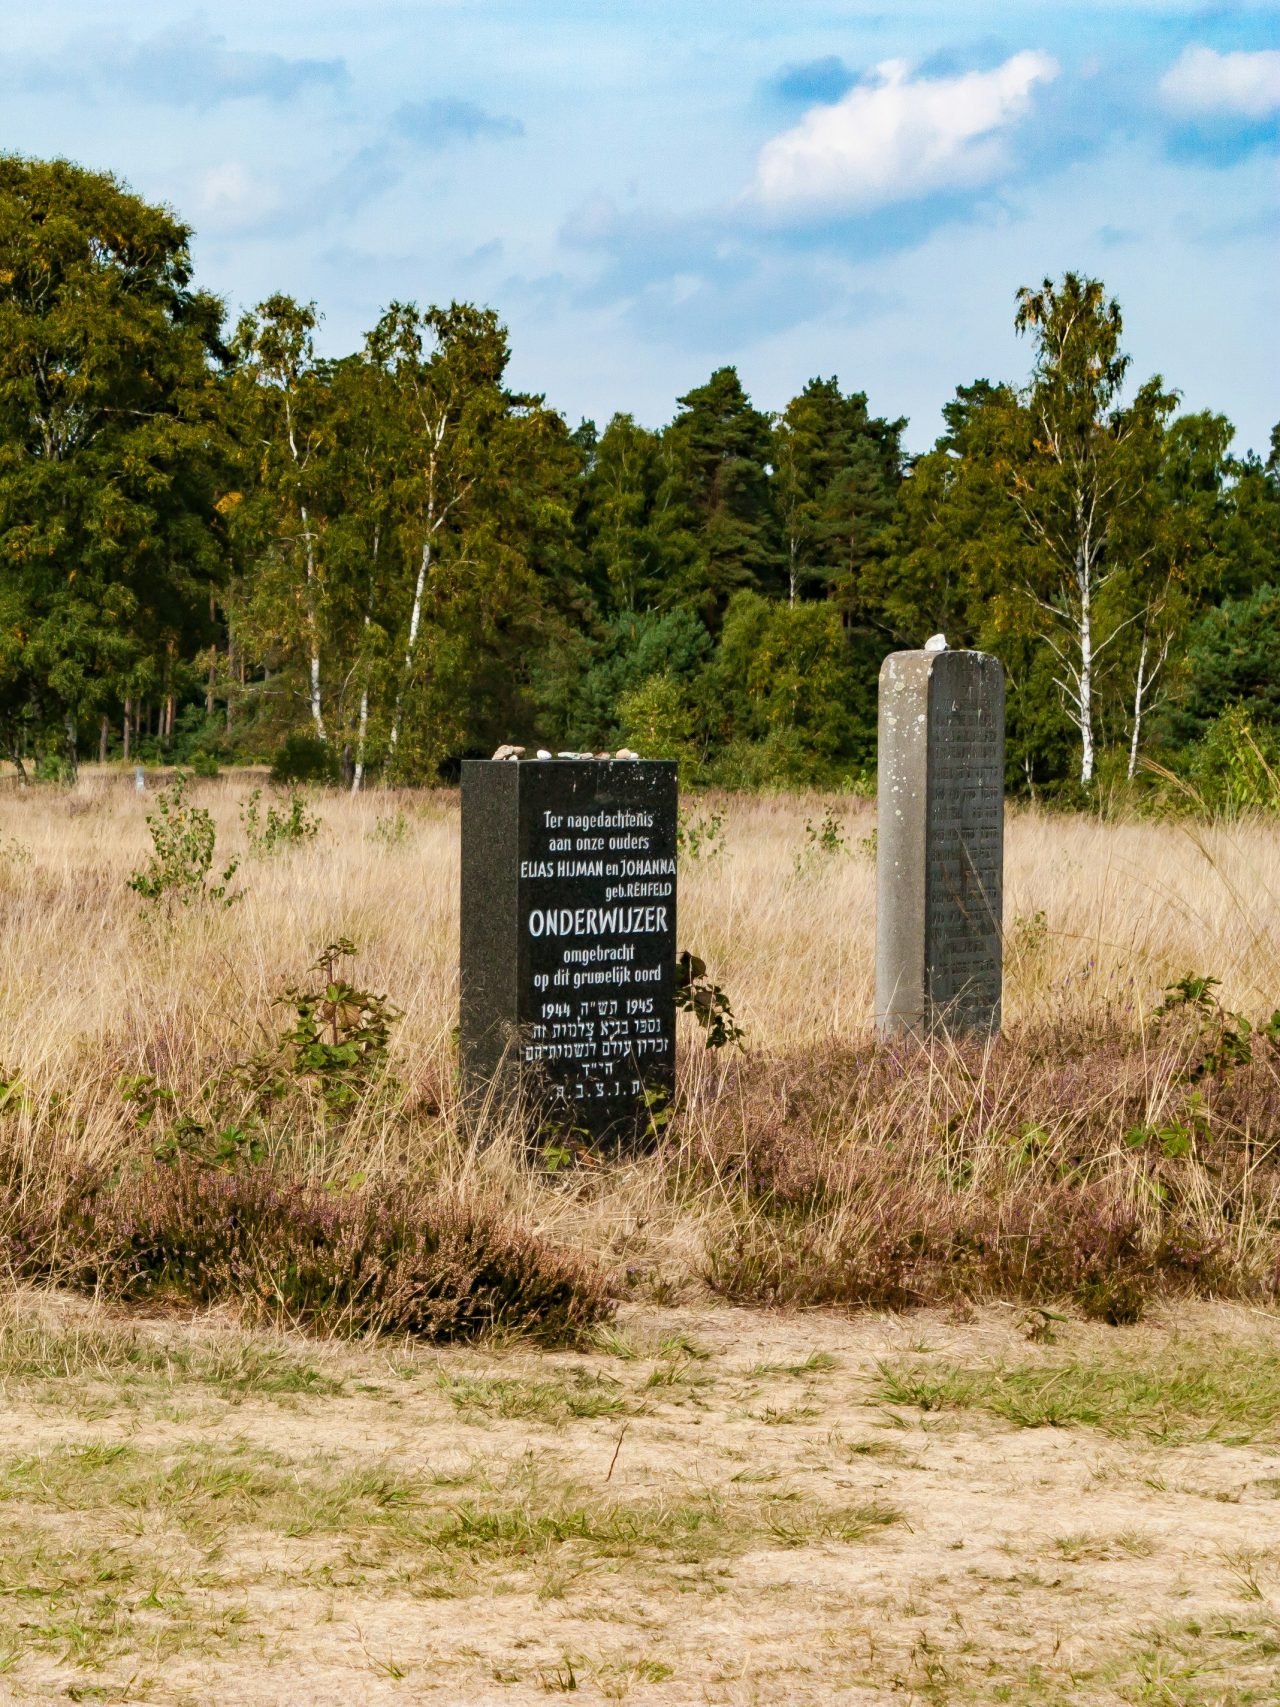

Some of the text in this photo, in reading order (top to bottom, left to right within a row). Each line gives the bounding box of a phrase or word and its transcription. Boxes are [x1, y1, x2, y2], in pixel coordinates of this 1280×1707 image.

[544, 810, 654, 832] Ter nagedachtenis
[549, 833, 649, 851] aan onze ouders
[521, 858, 676, 878] ELIAS HIJMAN en JOHANNA
[529, 907, 667, 936] ONDERWIJZER
[564, 944, 634, 965] omgebracht
[534, 965, 660, 992] op dit gruwelijk oord
[542, 1003, 570, 1019] 1944
[627, 998, 653, 1014] 1945
